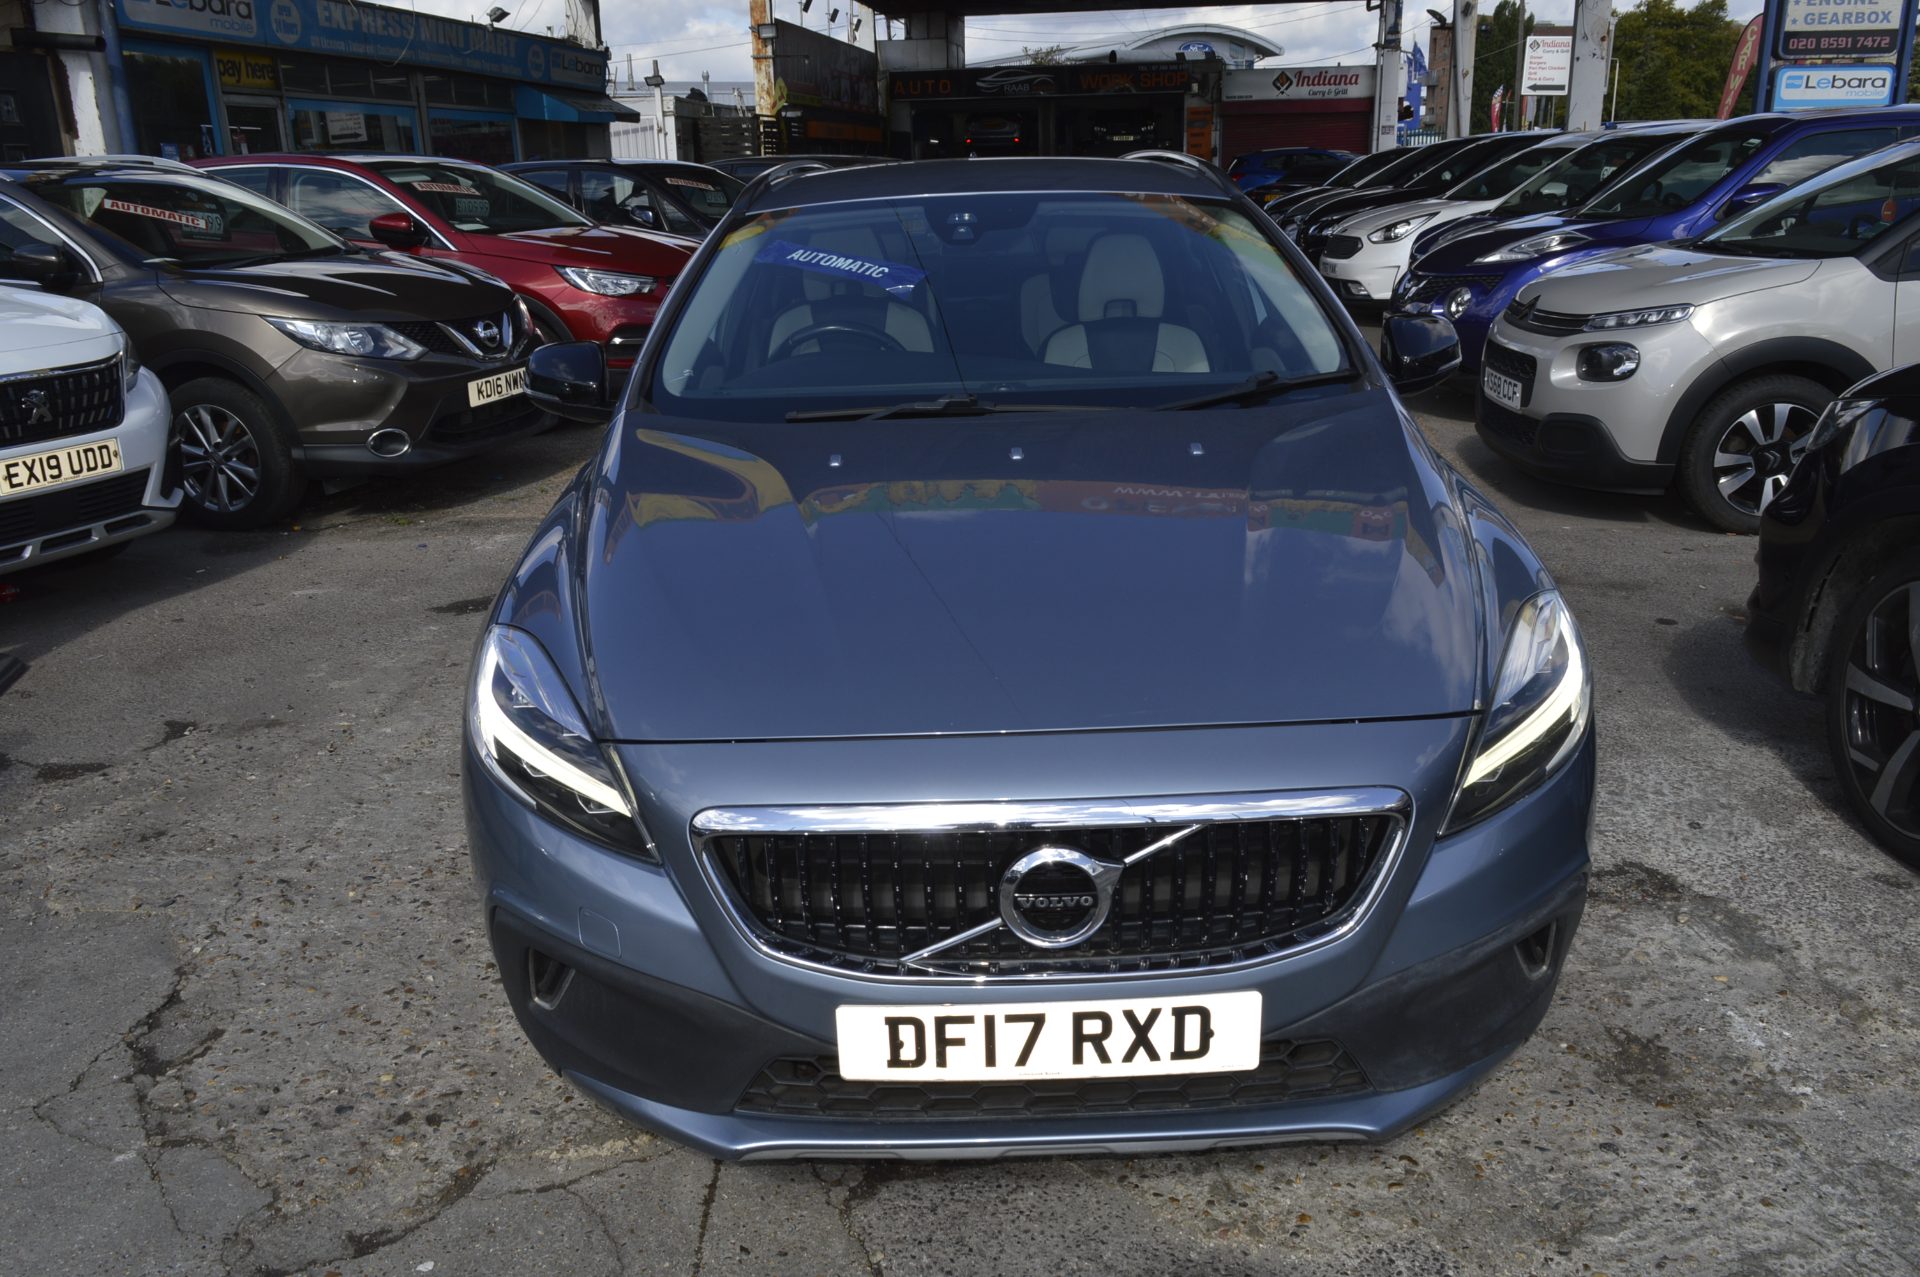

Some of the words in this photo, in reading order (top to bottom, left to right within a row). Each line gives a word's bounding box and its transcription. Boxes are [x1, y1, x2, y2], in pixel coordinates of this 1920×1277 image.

[210, 18, 254, 34] mobile
[1804, 11, 1892, 25] GEARBOX
[316, 0, 414, 40] EXPRESS
[469, 26, 520, 58] MART
[1541, 39, 1570, 49] Indiana
[1738, 25, 1758, 70] CAR
[1789, 38, 1816, 50] 020
[1821, 37, 1852, 49] 8591
[1856, 36, 1891, 48] 7472
[217, 57, 242, 83] pay
[244, 55, 274, 81] here
[562, 53, 603, 77] Lebara
[895, 79, 953, 97] AUTO
[1003, 84, 1030, 93] RAAB
[1079, 72, 1136, 90] WORK
[1140, 70, 1188, 88] SHOP
[1294, 70, 1360, 88] Indiana
[1804, 74, 1888, 90] Lebara
[1308, 88, 1326, 98] Curry
[1326, 88, 1333, 96] &
[1333, 87, 1349, 97] Grill
[1845, 90, 1885, 99] mobile
[110, 200, 202, 228] AUTOMATIC
[785, 249, 890, 278] AUTOMATIC
[476, 377, 504, 401] KD16
[1503, 379, 1519, 403] CCF
[4, 454, 62, 489] EX19
[67, 444, 113, 476] UDD
[1017, 895, 1094, 909] VOLVO
[884, 1013, 1047, 1069] DF17
[1072, 1005, 1215, 1066] RXD
